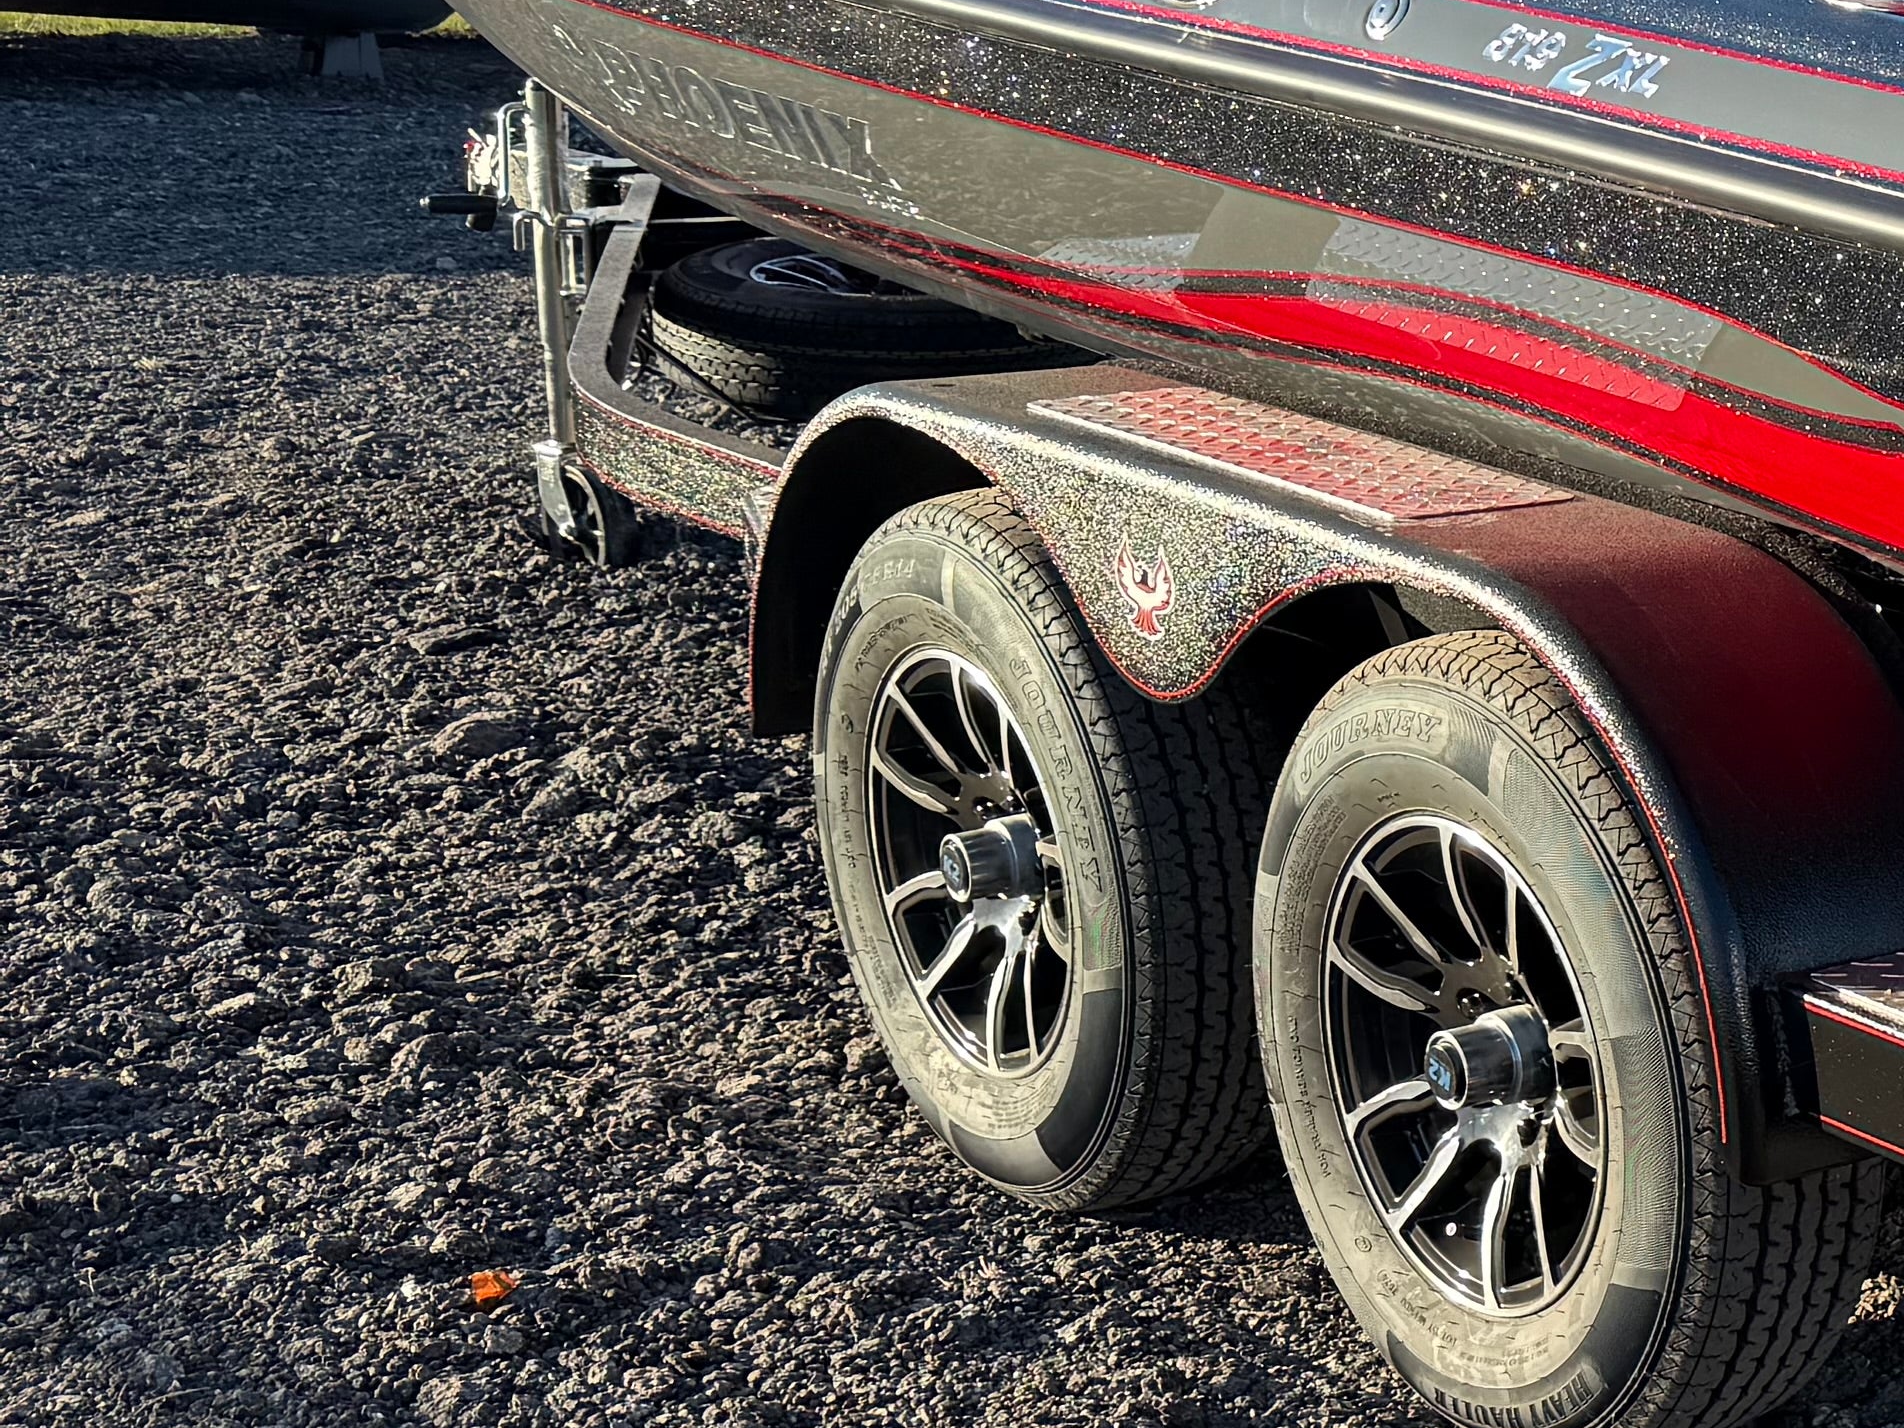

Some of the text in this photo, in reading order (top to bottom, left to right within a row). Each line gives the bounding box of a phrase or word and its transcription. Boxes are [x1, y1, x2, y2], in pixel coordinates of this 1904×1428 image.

[1546, 33, 1671, 98] ZXL
[1009, 656, 1104, 894] JOURNEY
[1300, 708, 1443, 784] JOURNEY
[1528, 1370, 1594, 1428] HEAVY
